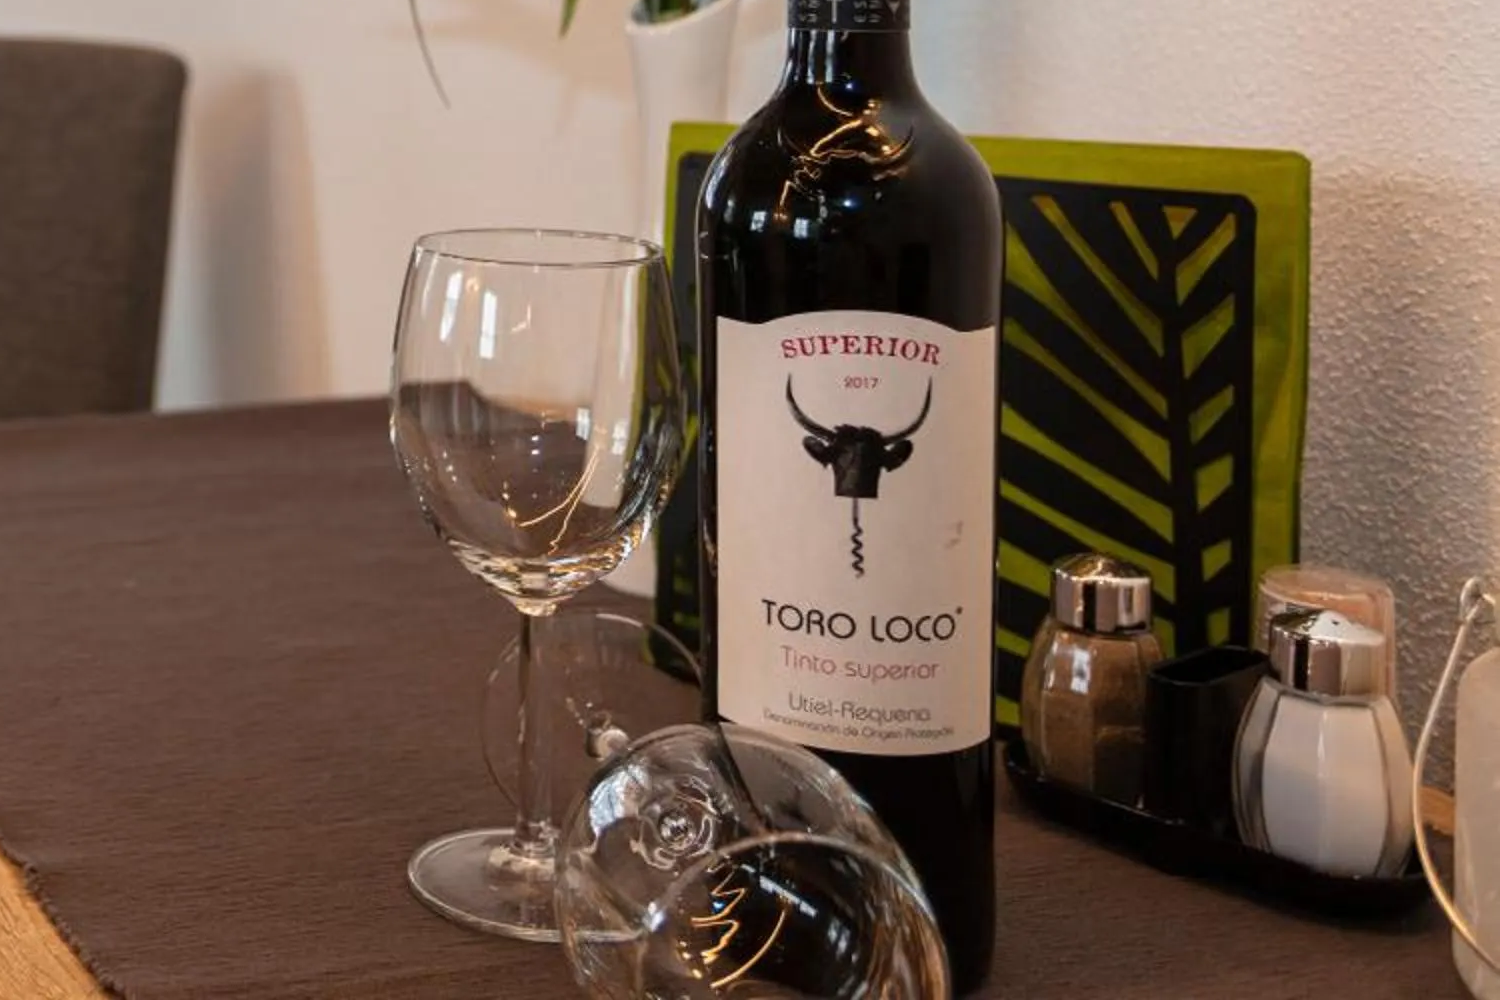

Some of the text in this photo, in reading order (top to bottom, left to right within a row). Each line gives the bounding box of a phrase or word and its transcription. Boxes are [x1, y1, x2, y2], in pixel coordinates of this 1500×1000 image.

[781, 335, 941, 366] SUPERIOR
[844, 376, 879, 389] 2017
[761, 599, 856, 639] TORO
[780, 645, 940, 685] Tinto superior
[788, 692, 931, 724] Utiel-Requena
[842, 725, 859, 738] de
